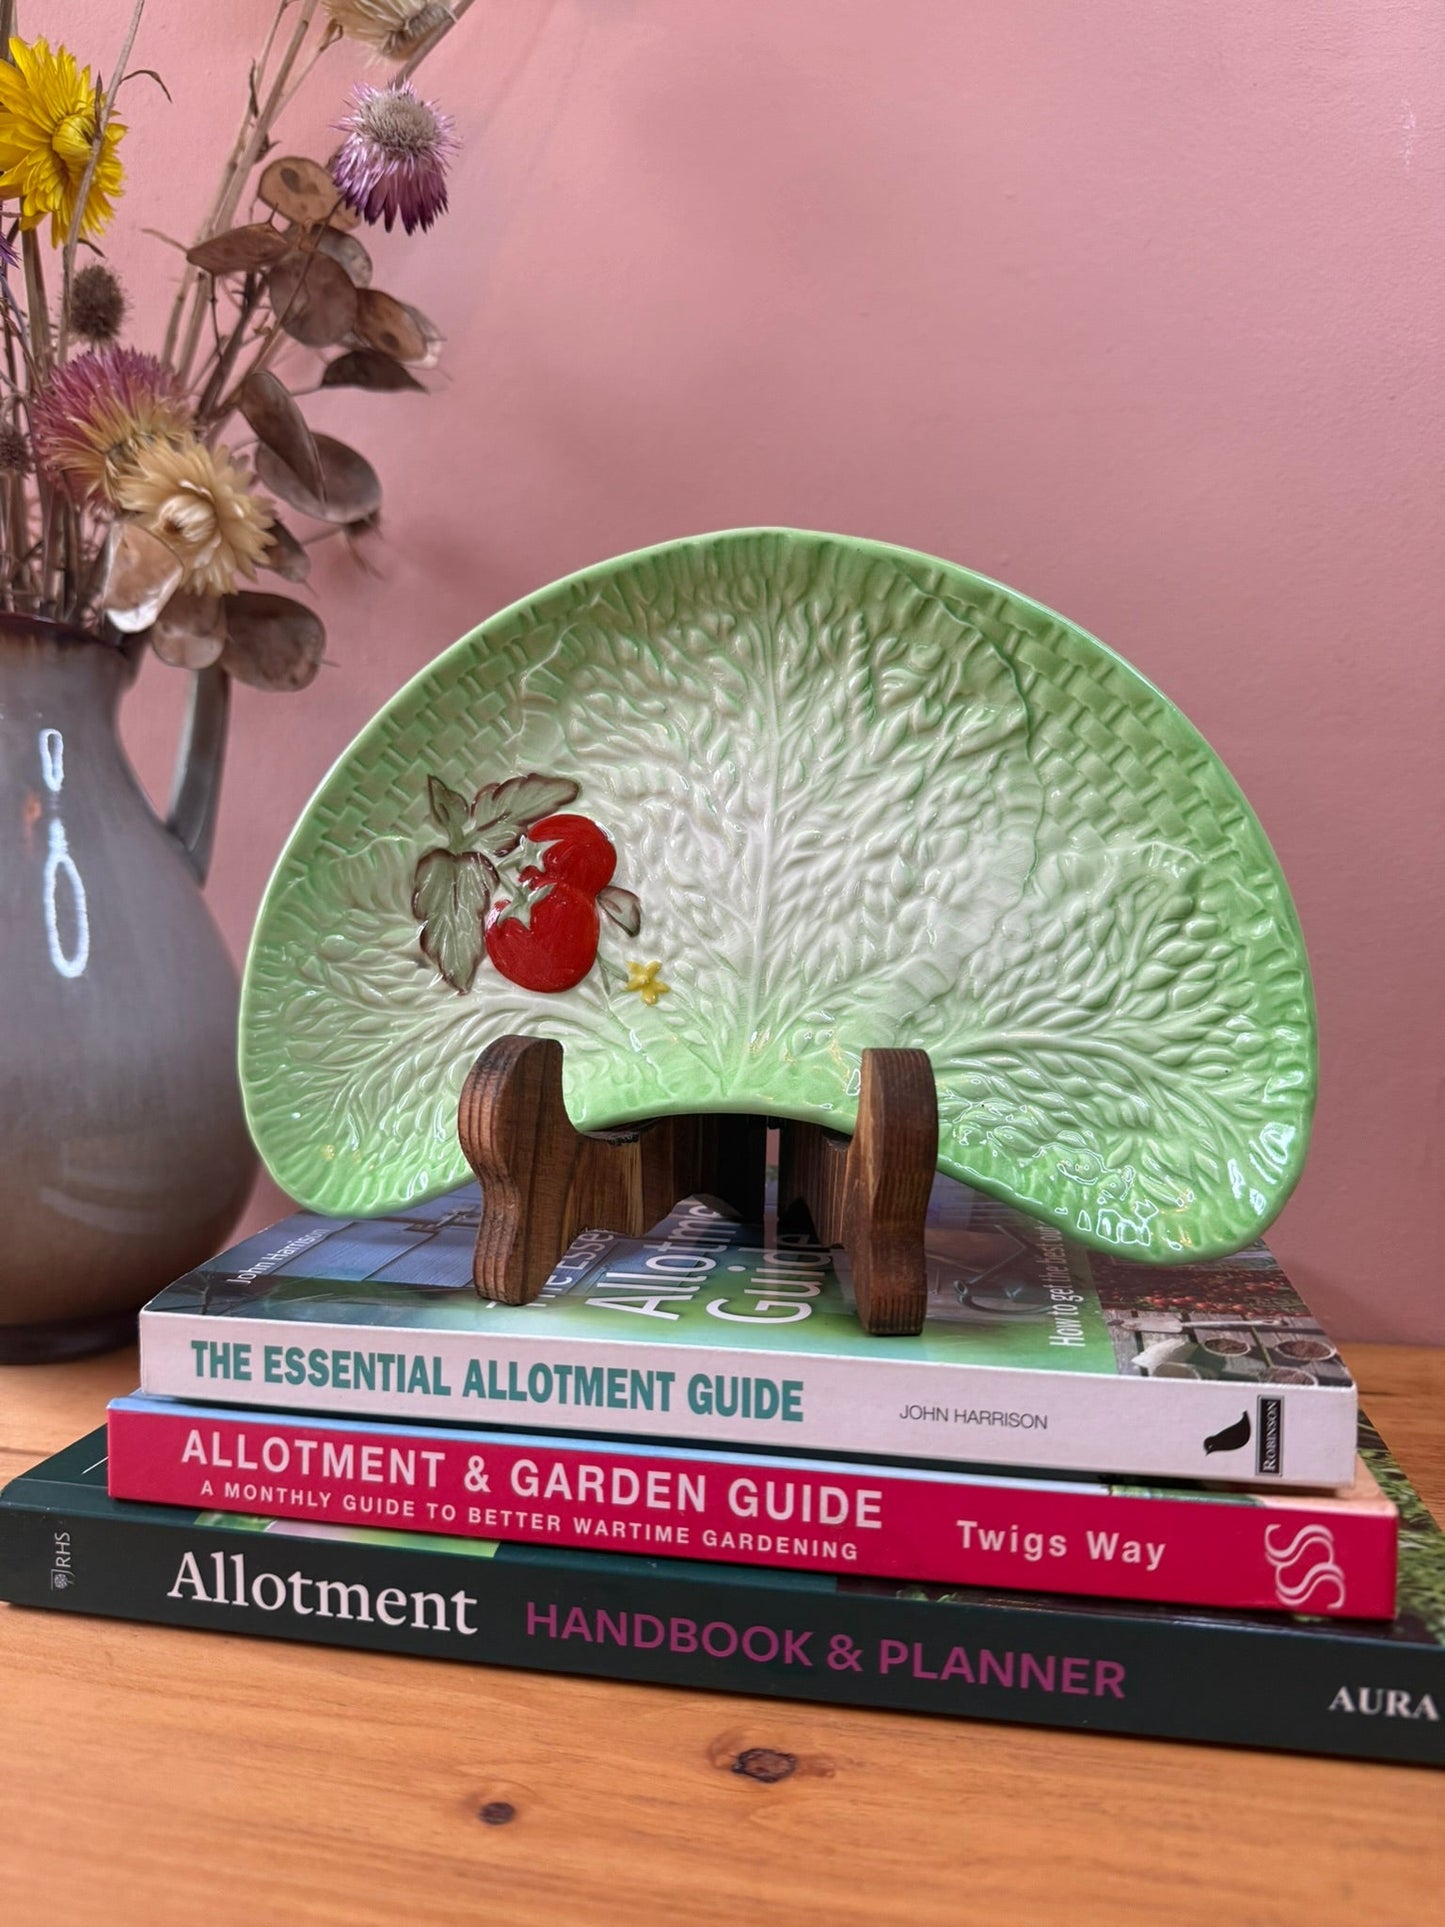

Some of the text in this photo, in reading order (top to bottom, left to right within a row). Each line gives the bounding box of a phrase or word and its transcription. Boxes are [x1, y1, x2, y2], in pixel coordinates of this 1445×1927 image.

[226, 1228, 331, 1284] John Harrison
[1035, 1243, 1067, 1264] best
[1038, 1266, 1071, 1283] the
[1042, 1285, 1084, 1302] get
[1047, 1303, 1079, 1315] to
[1048, 1317, 1086, 1347] How
[190, 1340, 804, 1422] THE ESSENTIAL ALLOTMENT GUIDE
[899, 1404, 1048, 1430] JOHN HARRISON
[1261, 1400, 1278, 1471] ROBINSON
[181, 1429, 883, 1529] ALLOTMENT & GARDEN GUIDE
[201, 1480, 858, 1561] A MONTHLY GUIDE TO BETTER WARTIME GARDENING
[54, 1532, 71, 1568] RHS
[956, 1520, 1166, 1572] Twigs Way
[166, 1551, 478, 1635] Allotment
[526, 1601, 1126, 1699] HANDBOOK & PLANNER
[1328, 1686, 1440, 1722] AURA
